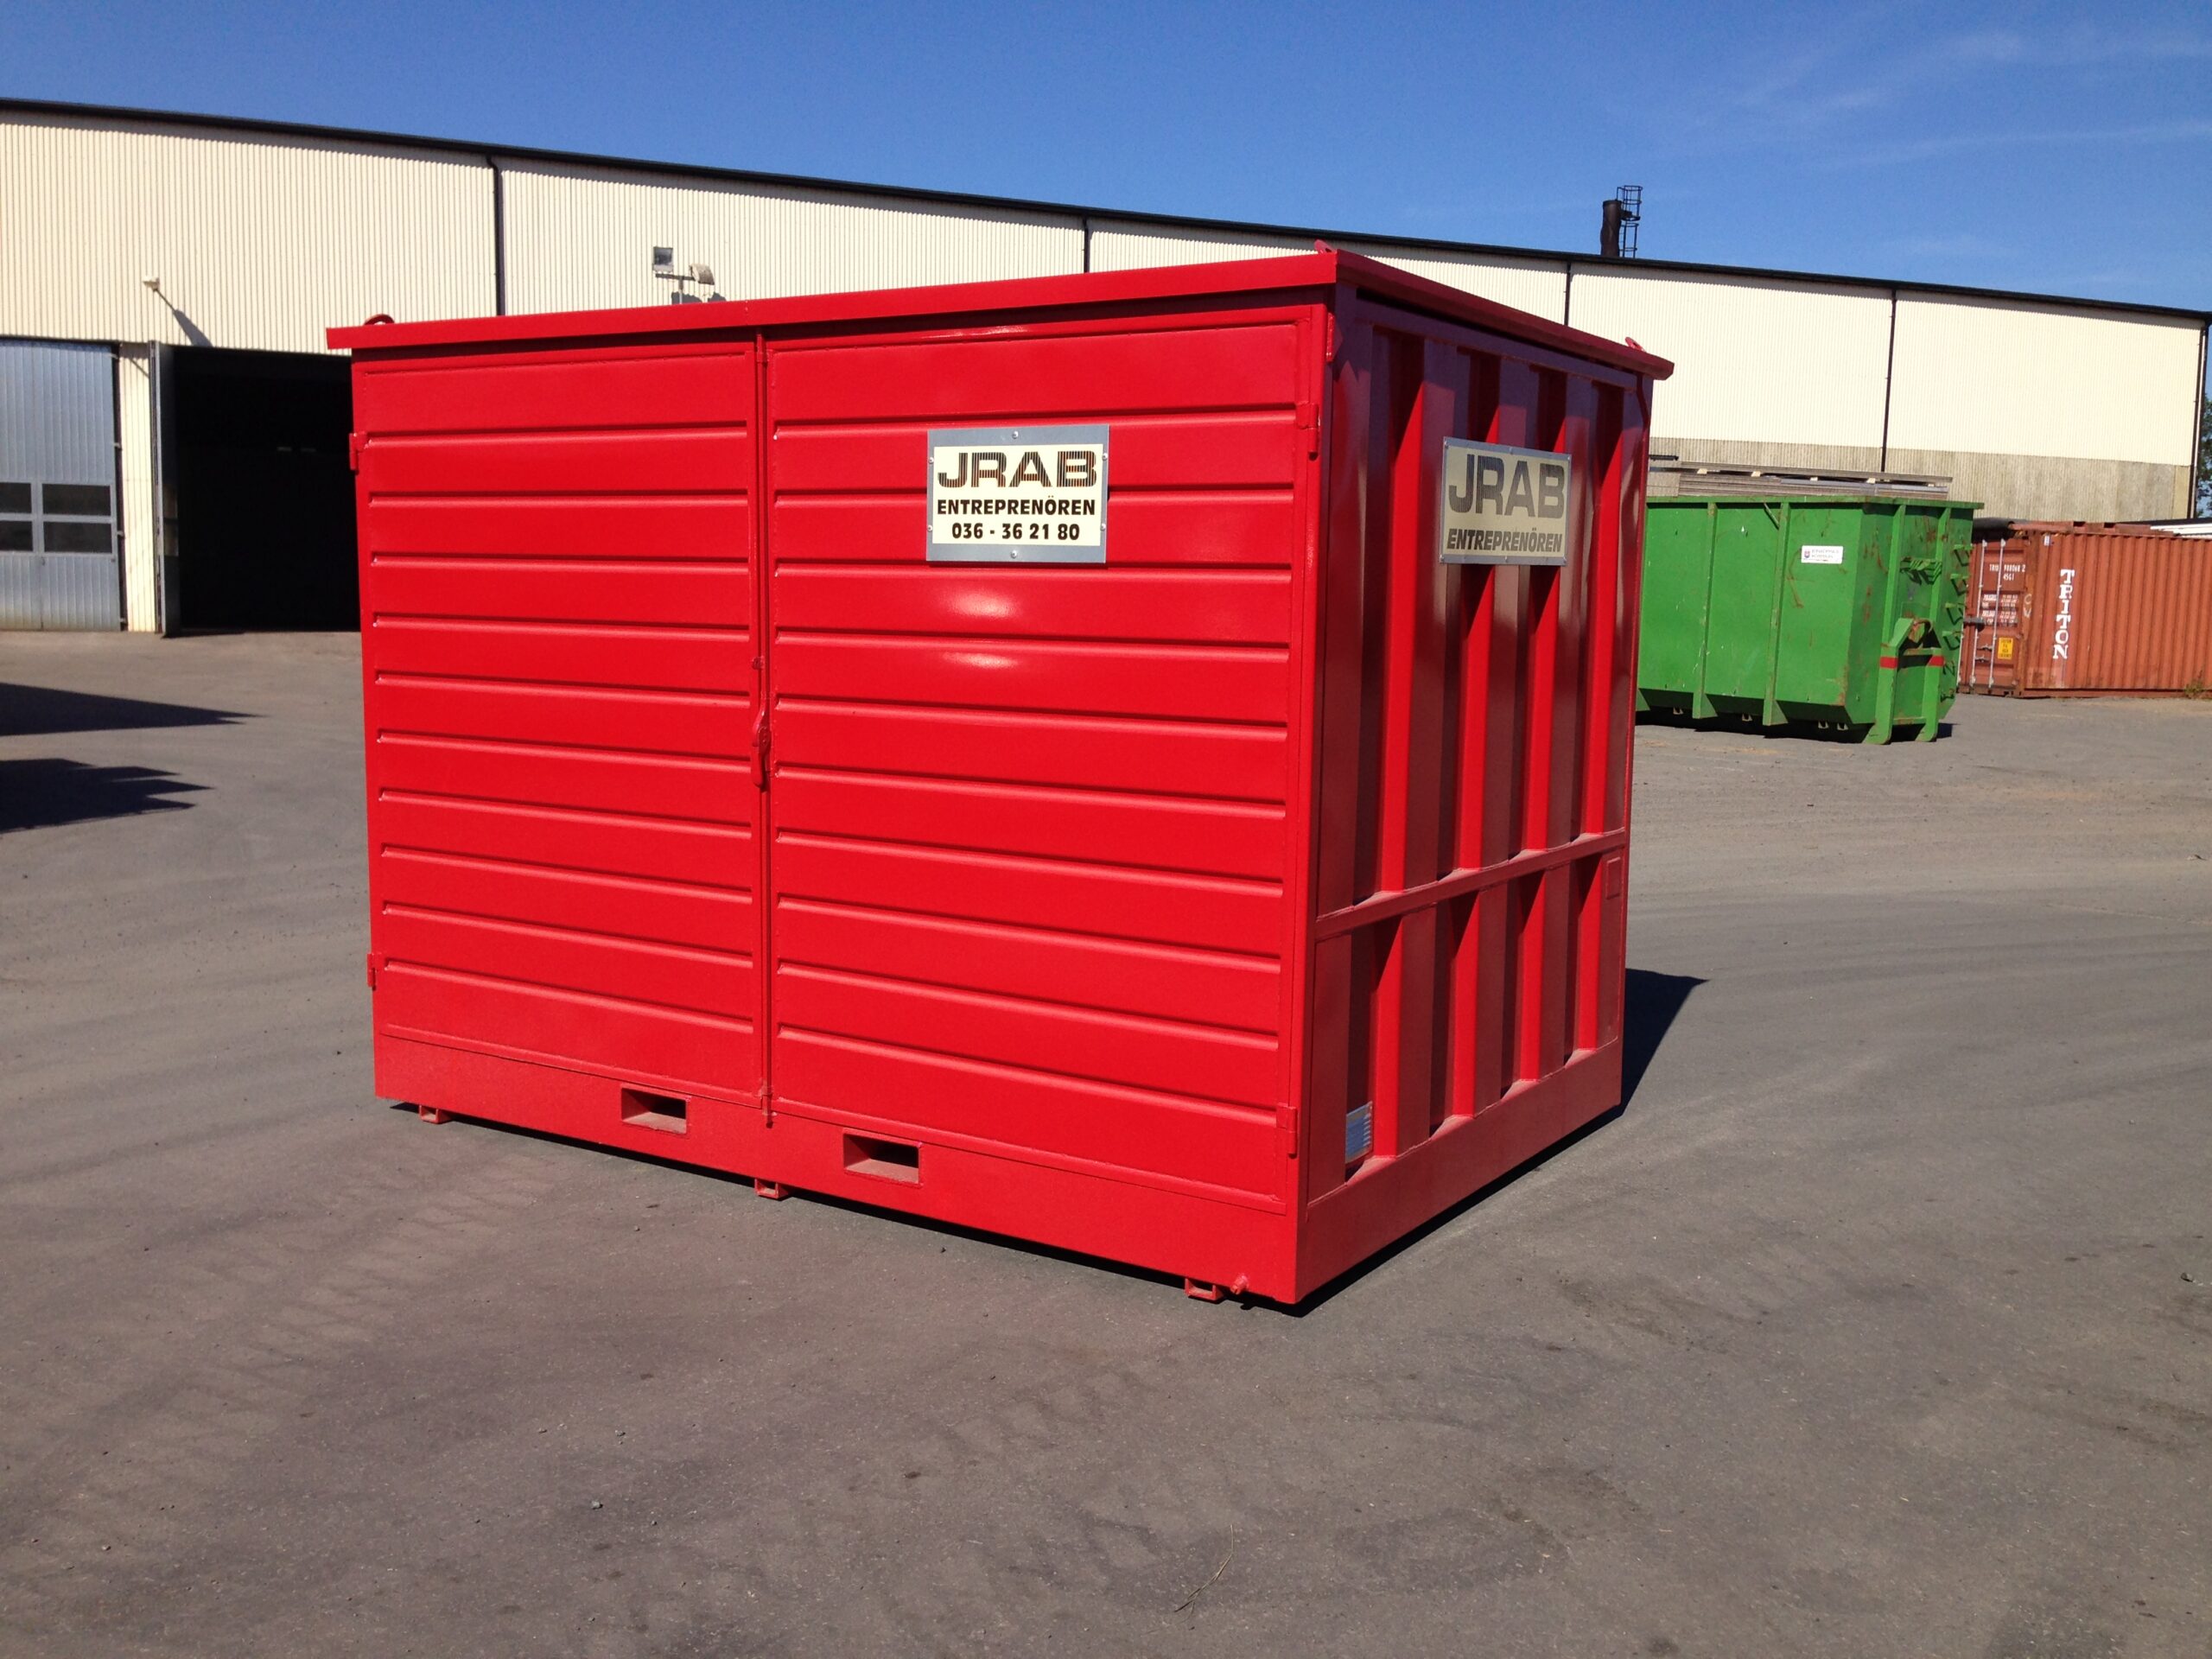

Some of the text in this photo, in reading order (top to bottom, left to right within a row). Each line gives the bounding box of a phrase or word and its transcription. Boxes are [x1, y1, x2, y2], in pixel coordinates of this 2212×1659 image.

[937, 450, 1097, 488] JRAB
[1448, 454, 1566, 519] JRAB
[937, 495, 1096, 516] ENTREPRENÖREN
[951, 523, 983, 539] 036
[1001, 523, 1023, 540] 36
[1029, 524, 1050, 540] 21
[1058, 524, 1080, 541] 80
[1446, 527, 1563, 553] ENTREPRENÖREN
[2052, 569, 2075, 659] TRITON
